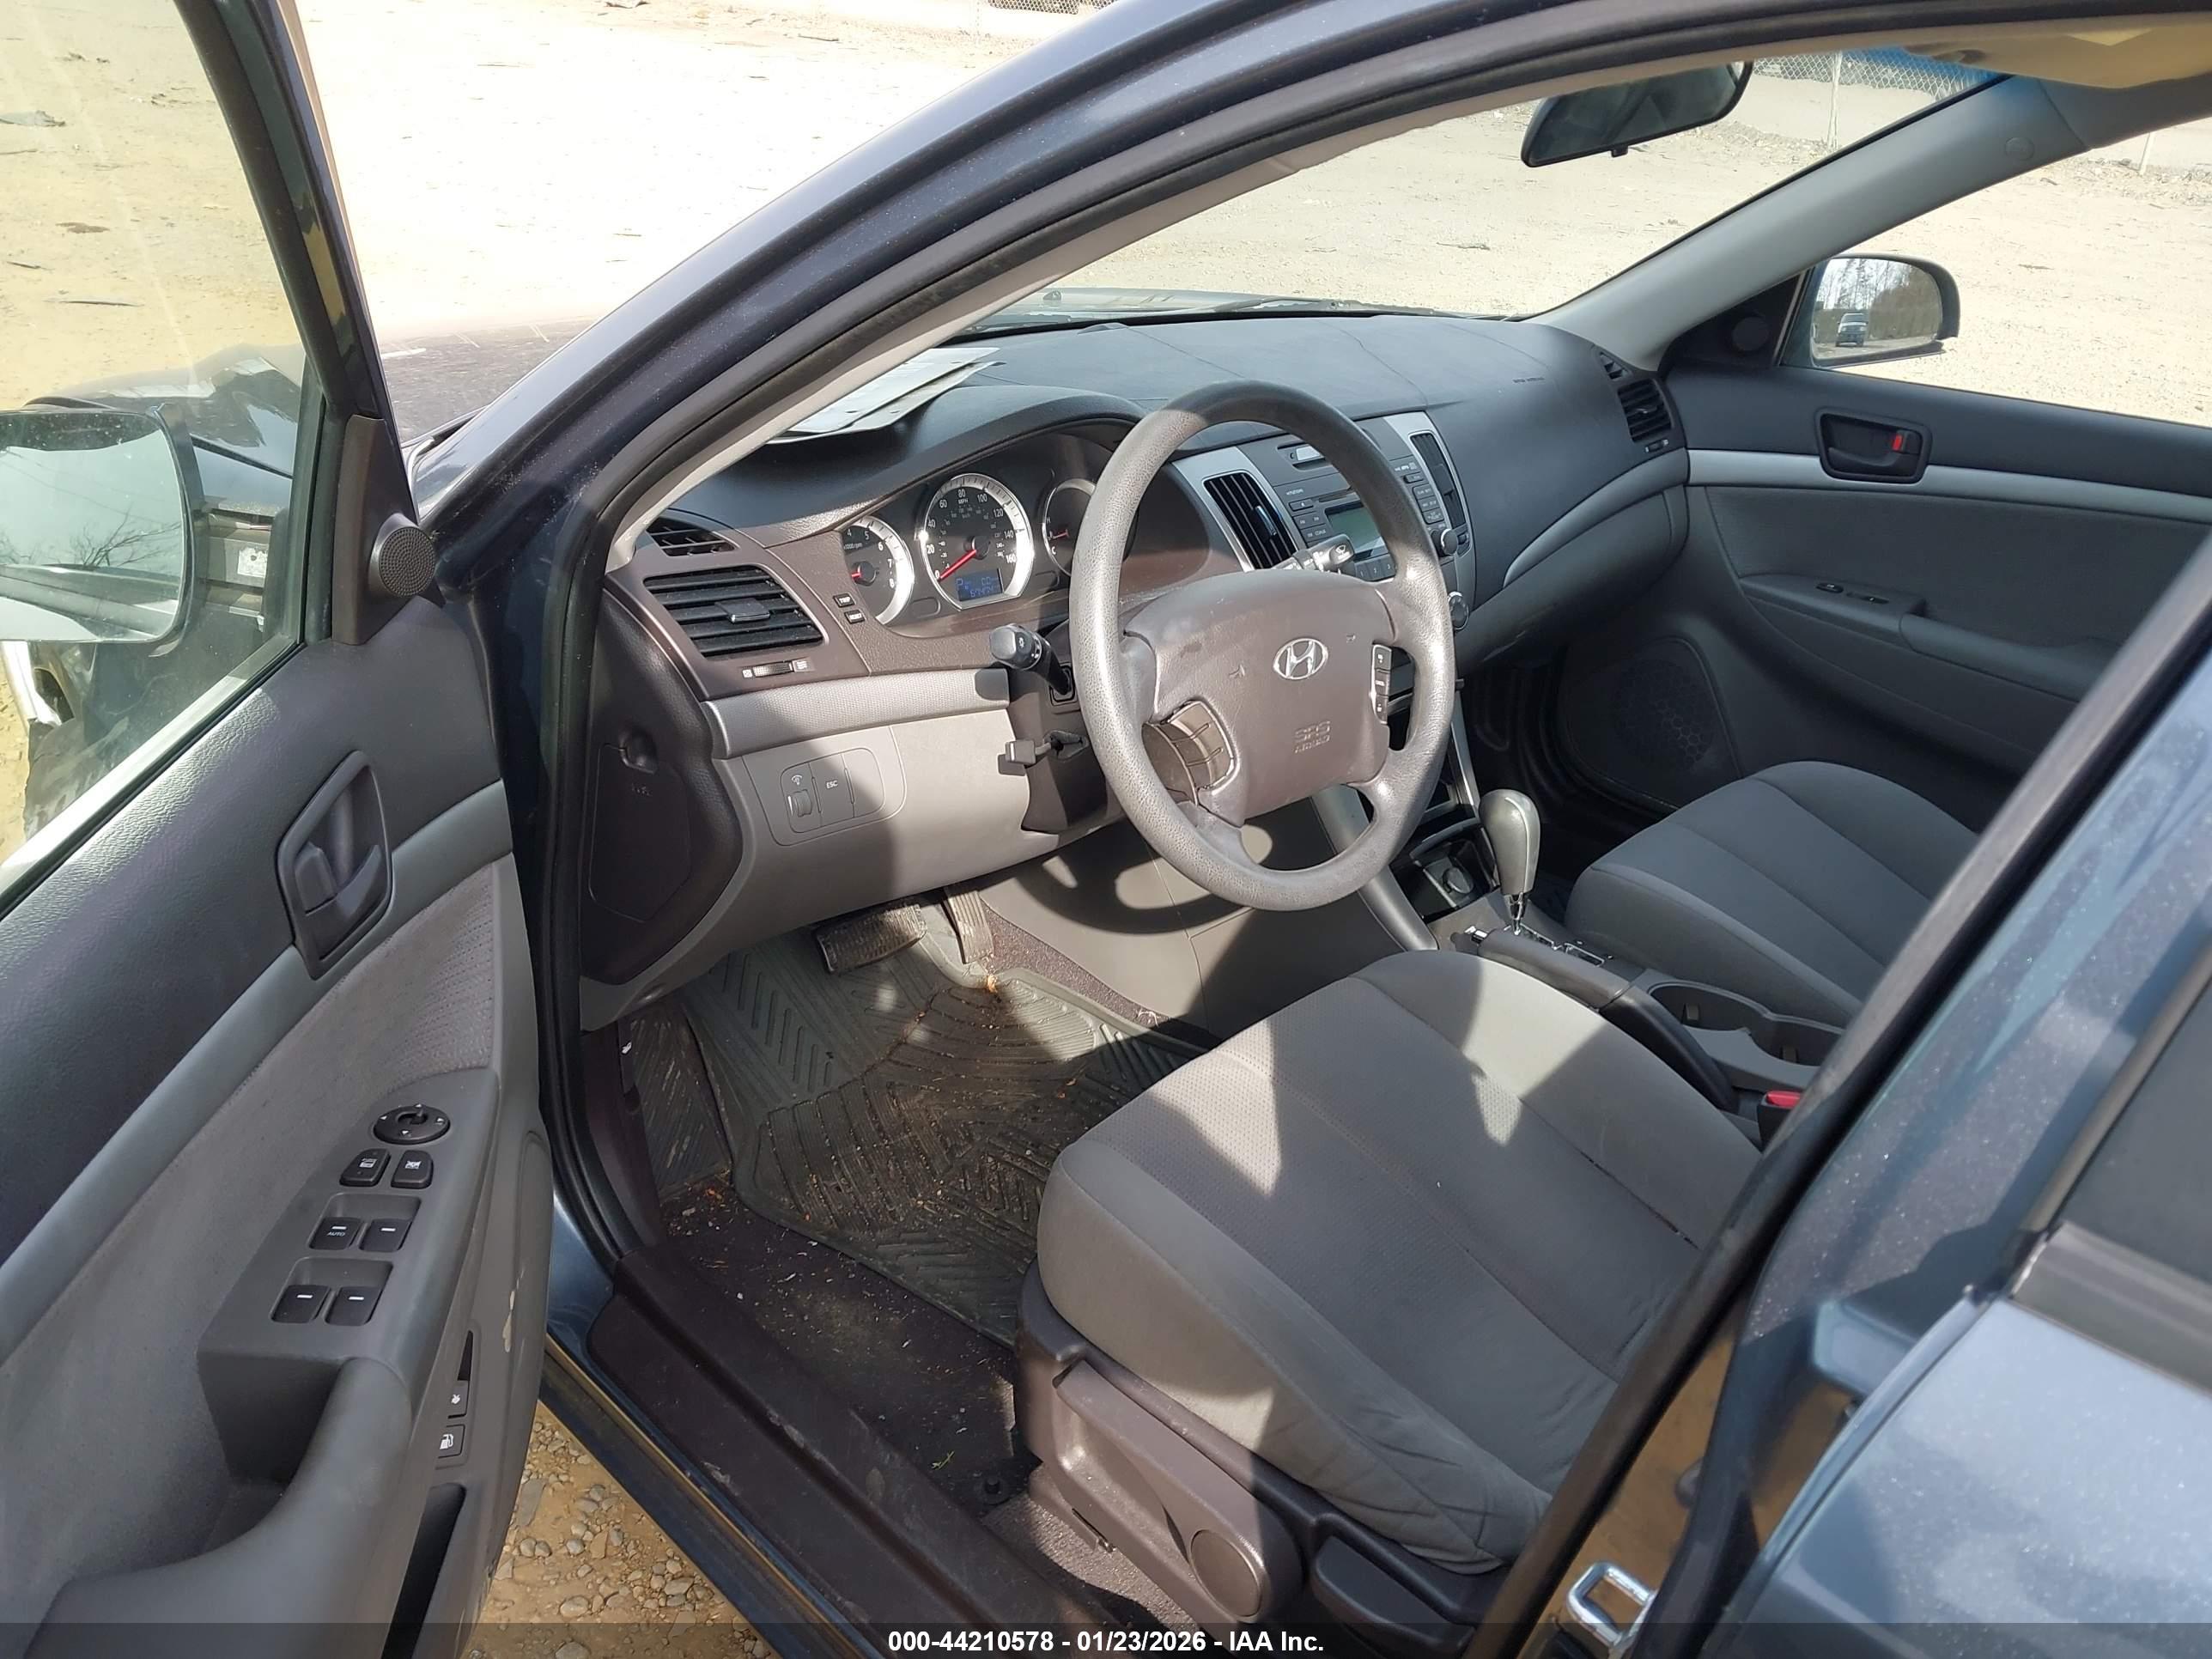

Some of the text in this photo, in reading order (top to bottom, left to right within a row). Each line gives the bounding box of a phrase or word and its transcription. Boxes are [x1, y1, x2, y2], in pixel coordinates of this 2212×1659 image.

[958, 489, 966, 497] 80
[977, 494, 988, 502] 100
[939, 499, 947, 507] 60
[994, 508, 1004, 517] 120
[928, 520, 936, 528] 40
[847, 528, 852, 537] 4
[864, 531, 870, 540] 5
[1004, 530, 1014, 539] 140
[878, 541, 884, 551] 6
[927, 544, 935, 554] 20
[1052, 546, 1056, 555] C
[887, 558, 892, 568] 7
[1006, 553, 1017, 564] 160
[934, 570, 940, 579] 0
[826, 780, 838, 789] ESC
